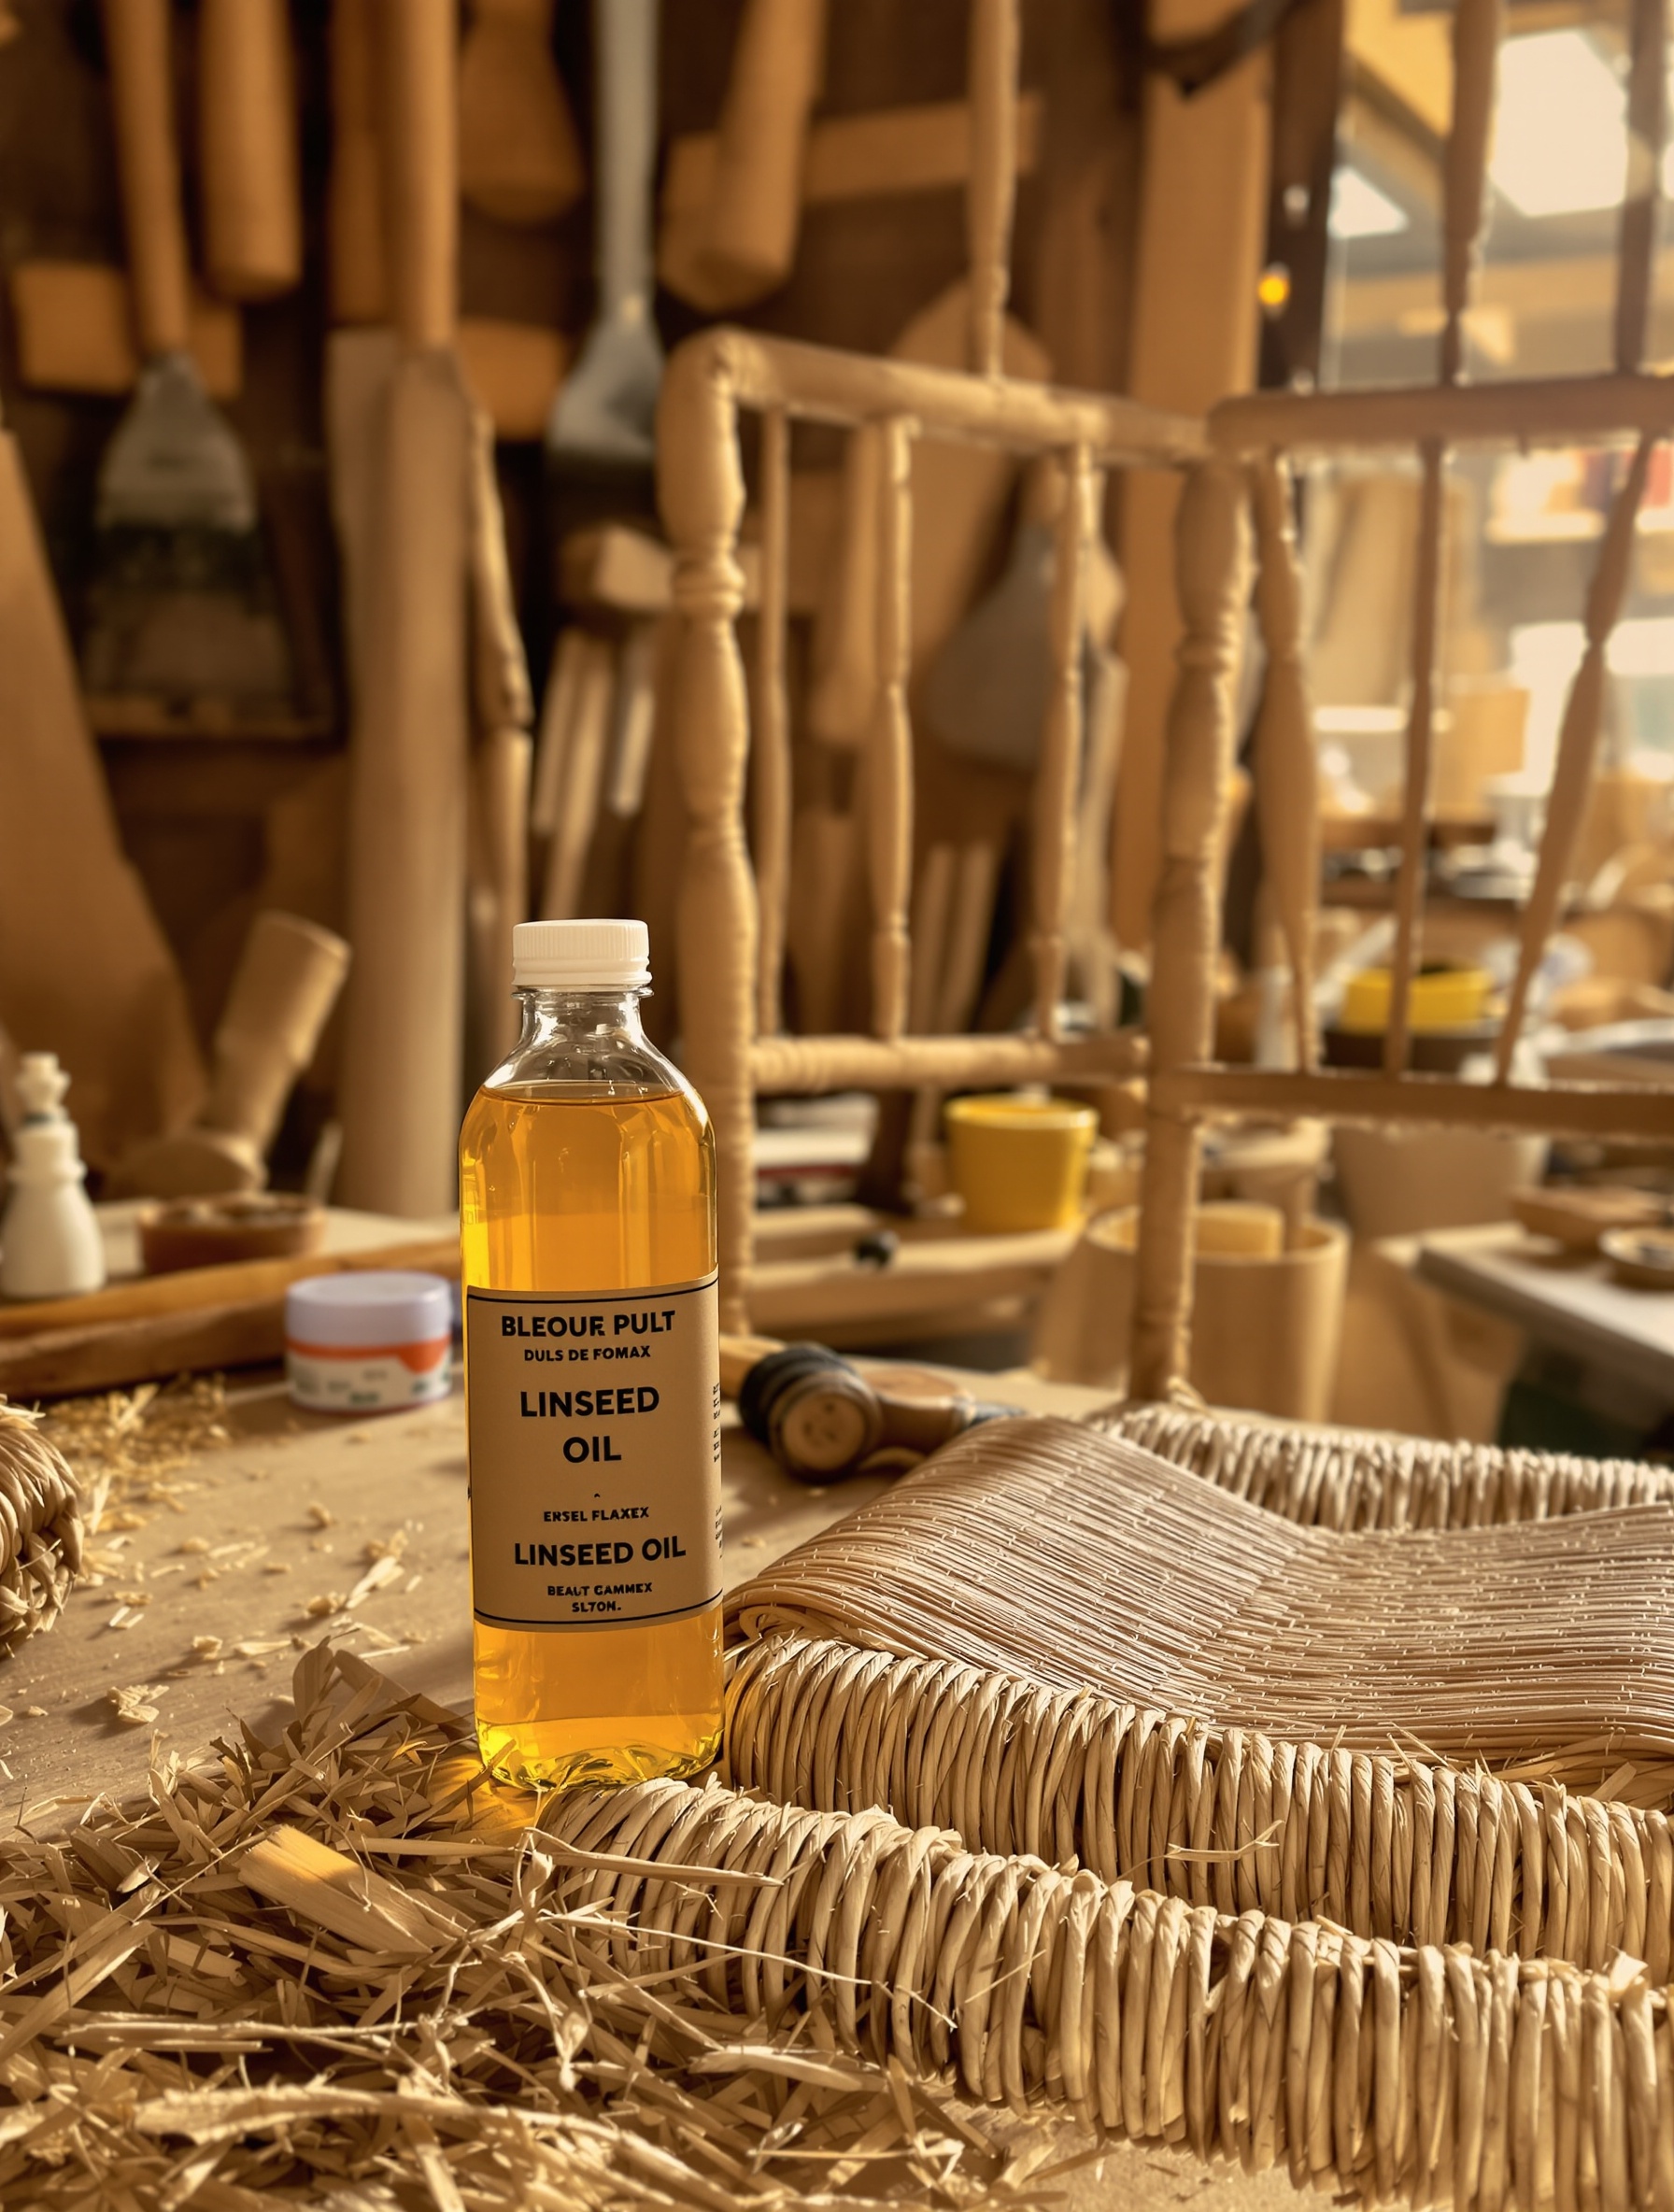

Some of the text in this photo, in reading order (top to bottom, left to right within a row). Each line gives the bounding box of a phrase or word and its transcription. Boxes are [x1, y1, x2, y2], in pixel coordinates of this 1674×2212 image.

[613, 1310, 676, 1336] PULT
[524, 1345, 651, 1362] DULS DE FOMAX
[519, 1386, 660, 1418] LINSEED
[562, 1435, 622, 1464] OIL
[514, 1535, 687, 1567] LINSEED OIL
